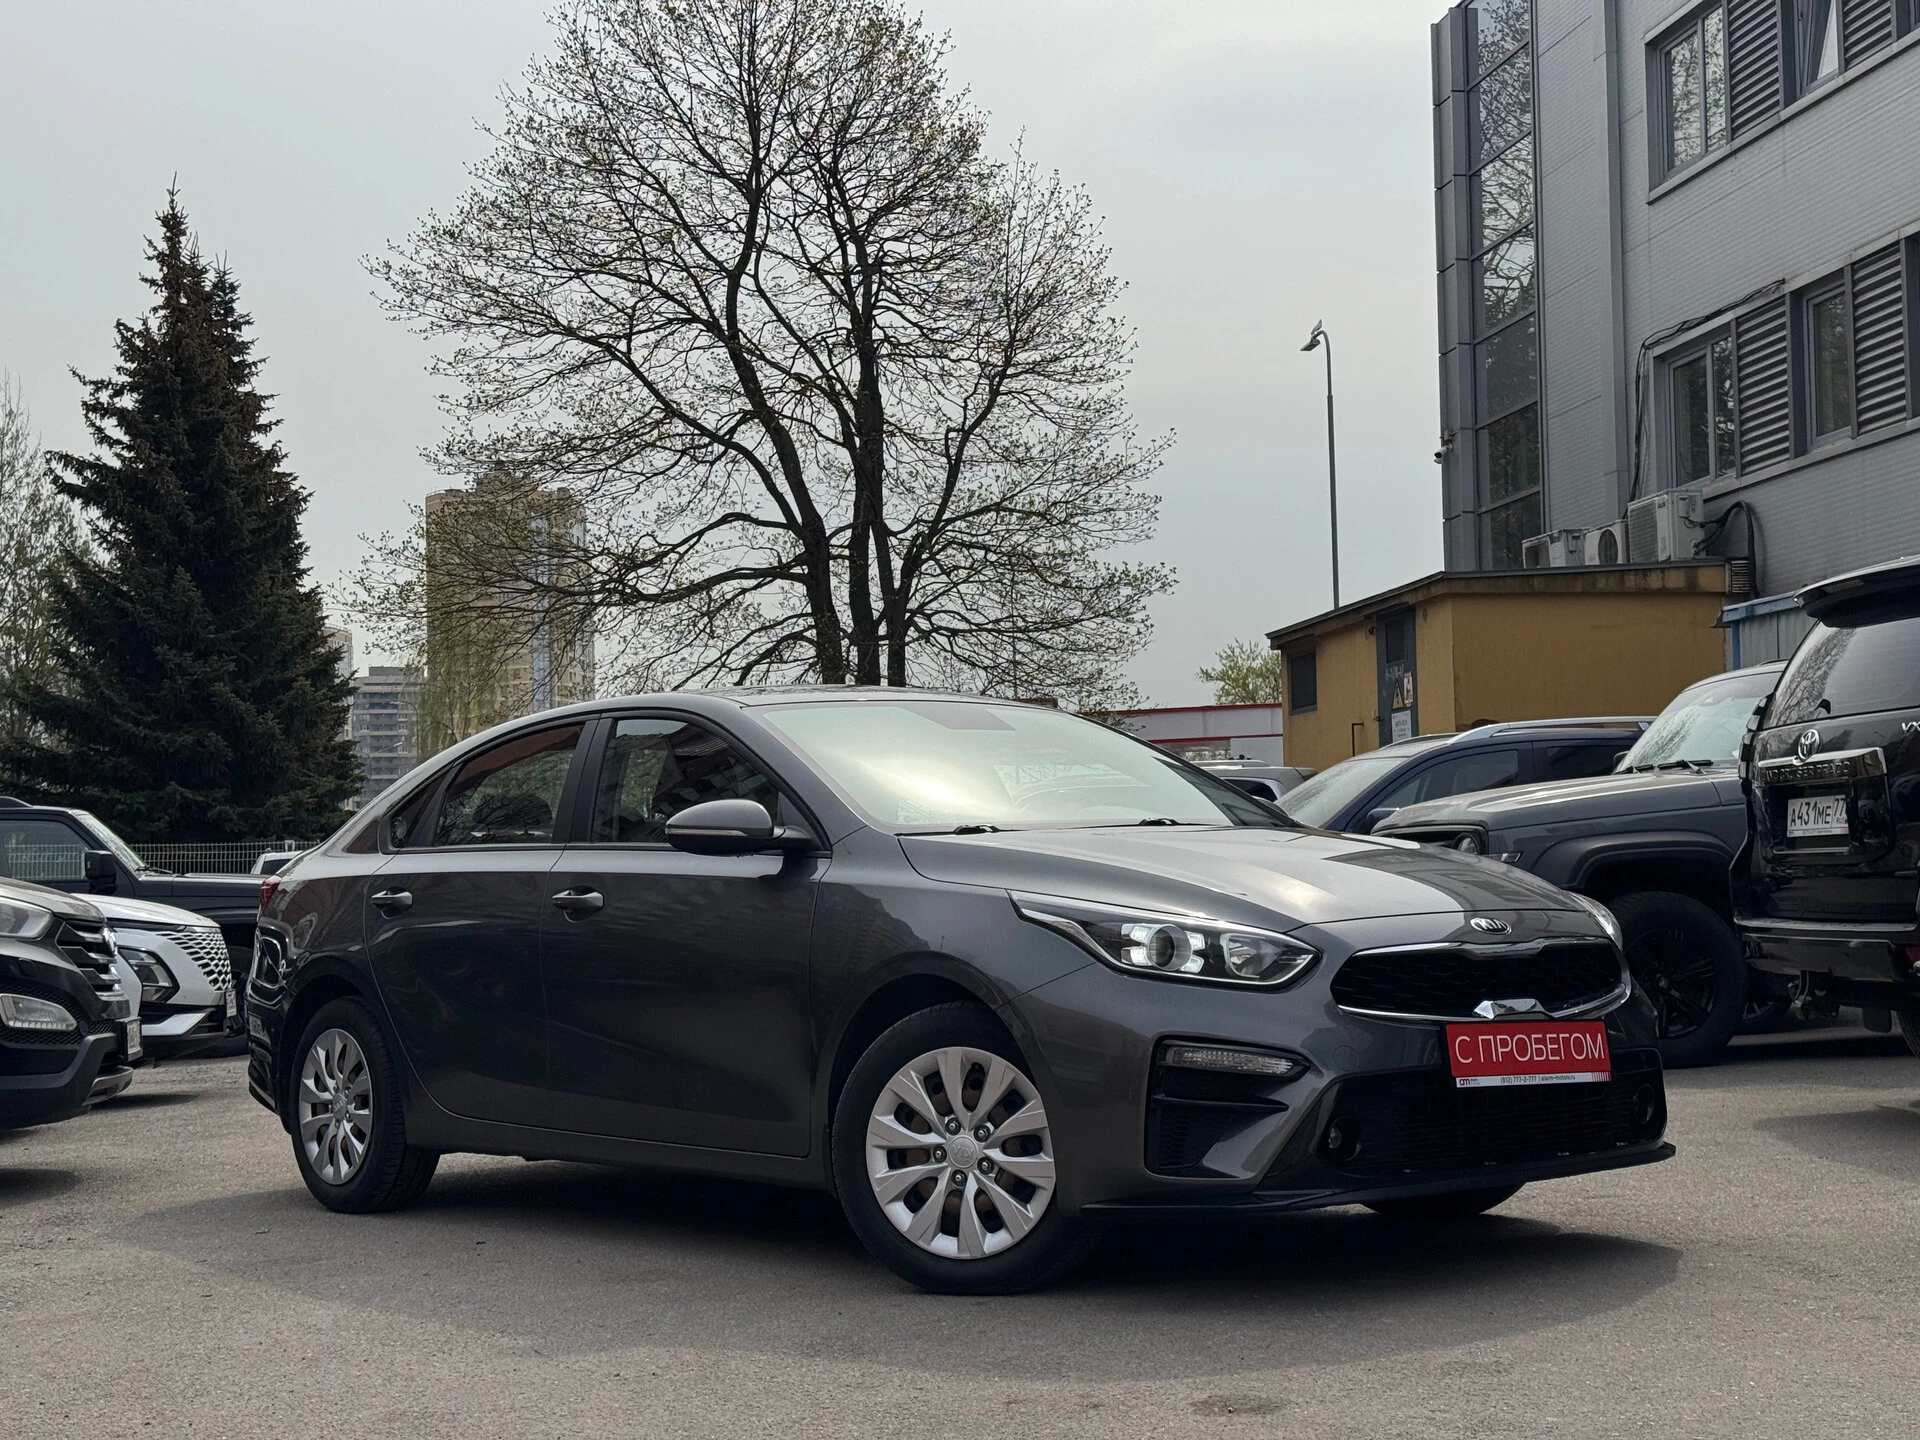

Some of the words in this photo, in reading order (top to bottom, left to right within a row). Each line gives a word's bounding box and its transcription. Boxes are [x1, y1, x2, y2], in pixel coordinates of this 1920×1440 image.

[1473, 918, 1508, 931] KIA
[1455, 1036, 1473, 1064] С
[1478, 1033, 1605, 1063] ПРОБЕГОМ
